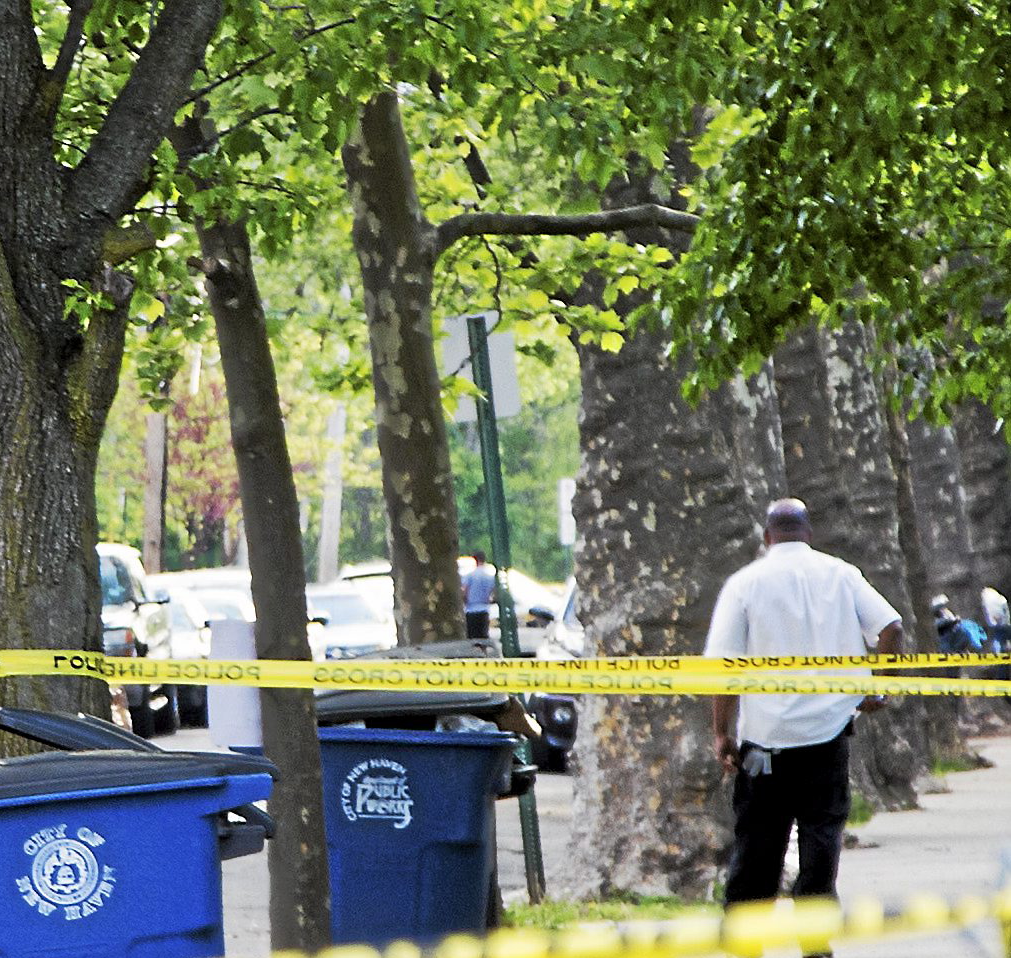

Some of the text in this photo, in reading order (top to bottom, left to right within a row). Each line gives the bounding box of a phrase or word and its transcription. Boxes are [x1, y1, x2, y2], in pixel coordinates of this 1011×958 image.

[607, 658, 681, 671] POLICE
[722, 656, 796, 668] CROSS
[800, 655, 843, 667] NOT
